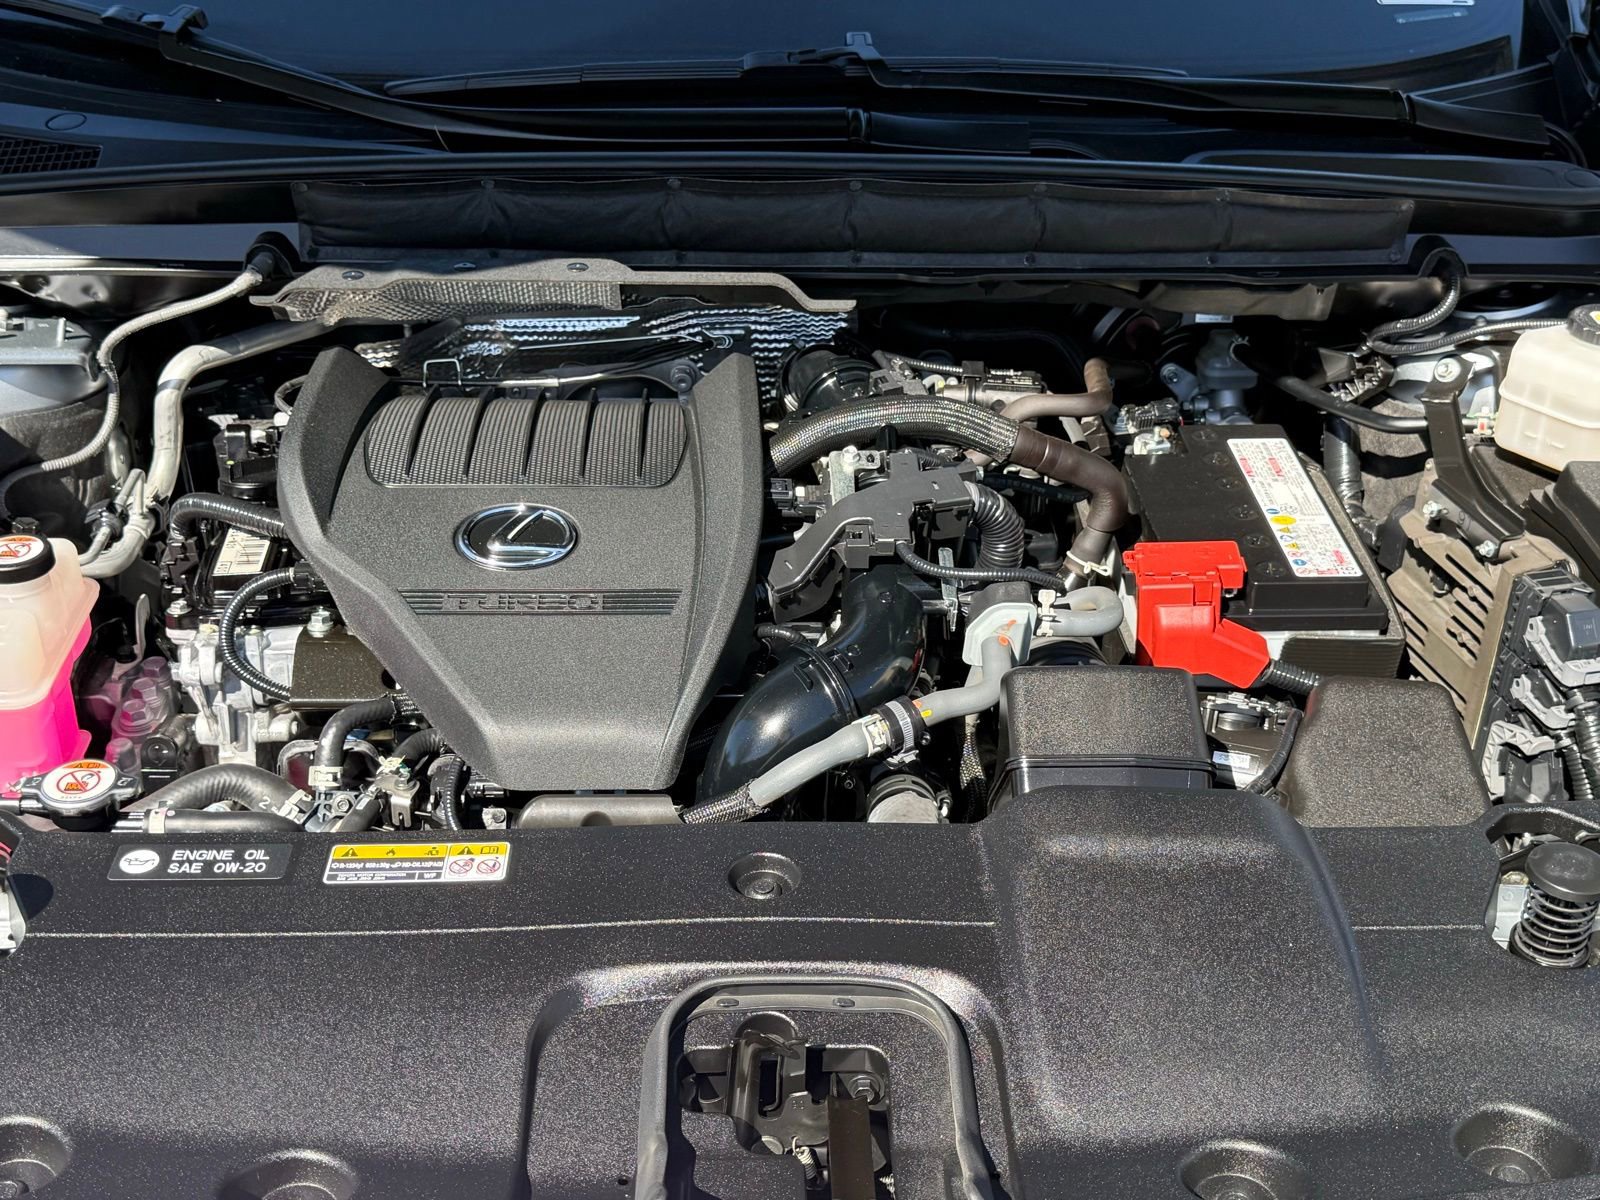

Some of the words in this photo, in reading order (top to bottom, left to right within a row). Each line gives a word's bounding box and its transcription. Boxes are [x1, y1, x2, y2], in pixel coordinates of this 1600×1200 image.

[447, 593, 599, 610] TURBO
[171, 849, 235, 861] ENGINE
[244, 849, 270, 860] OIL
[167, 862, 203, 874] SAE
[213, 862, 267, 873] 0W-20
